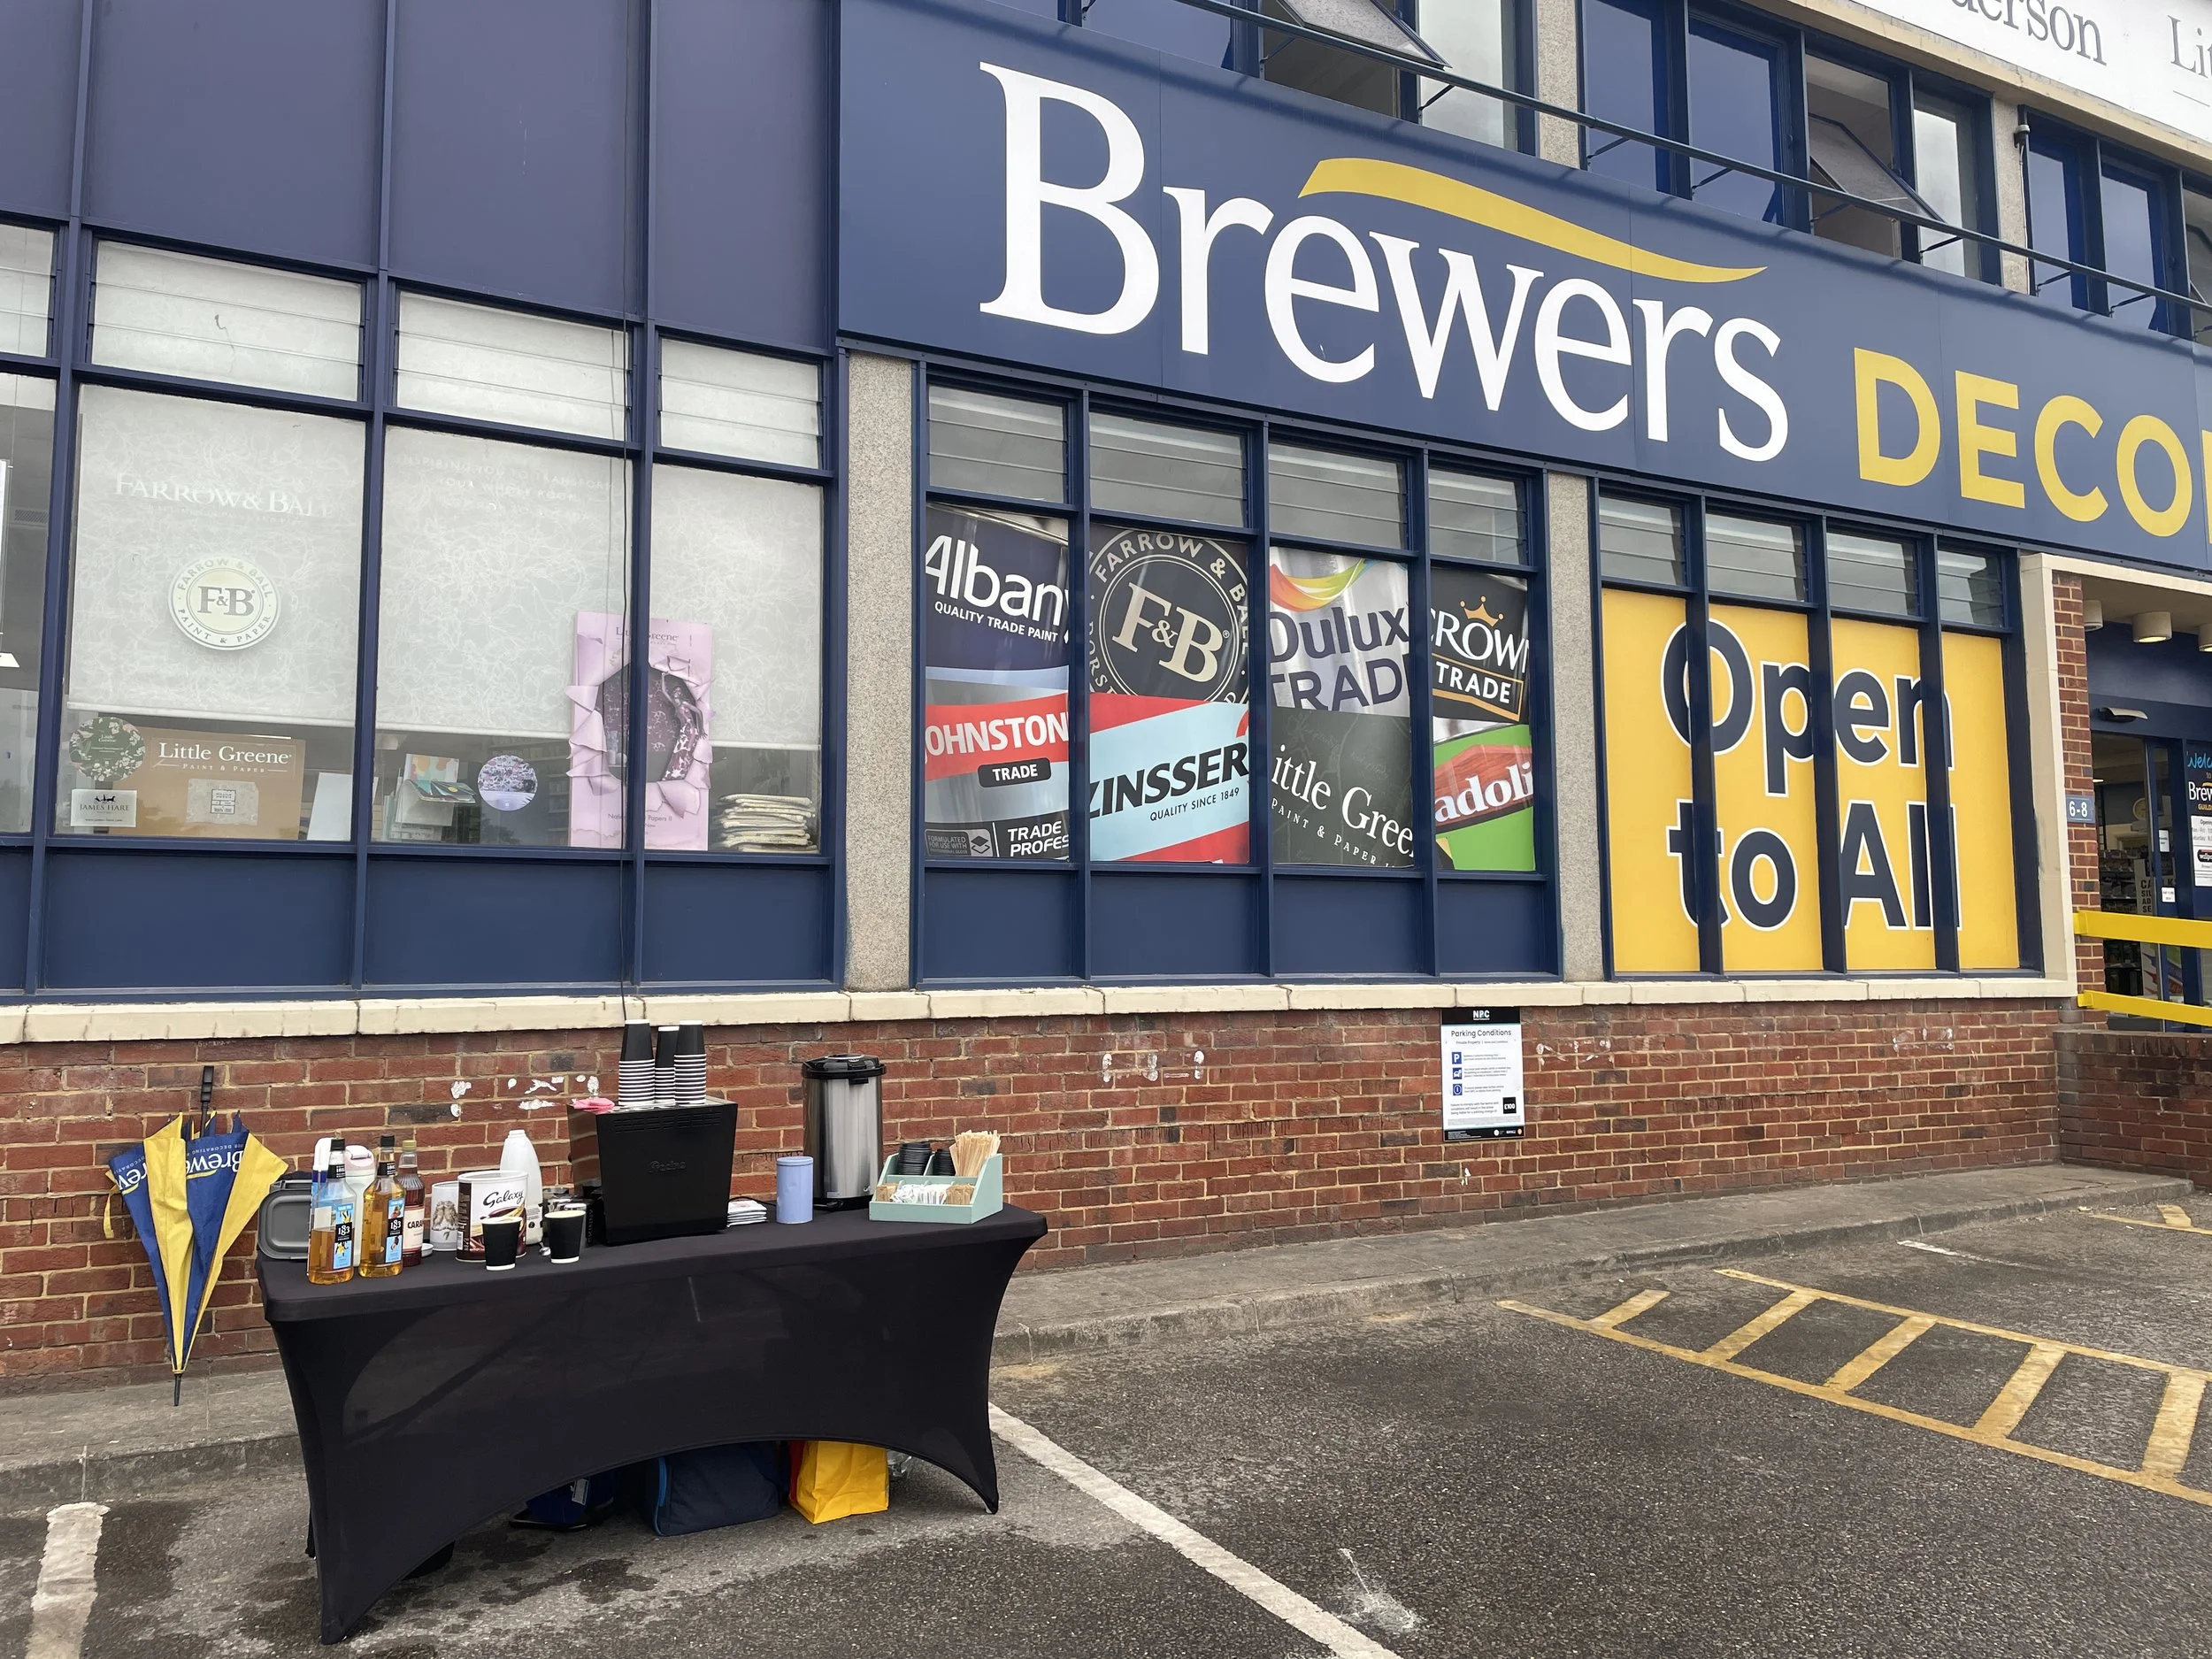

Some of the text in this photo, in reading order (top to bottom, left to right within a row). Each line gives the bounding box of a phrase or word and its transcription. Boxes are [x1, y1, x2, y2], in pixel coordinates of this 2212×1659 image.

[2168, 15, 2212, 78] Li
[979, 61, 2212, 544] Brewers DECO
[116, 472, 242, 509] FARROW
[177, 558, 228, 590] FARROW
[1094, 533, 1203, 583] FARROW
[1210, 557, 1226, 580] &
[197, 586, 254, 616] F&B
[925, 534, 1069, 626] Alban
[178, 608, 211, 640] PAINT
[236, 616, 271, 642] PAPER
[934, 601, 1058, 642] QUALITY TRADE PAINT
[1111, 581, 1224, 683] F&B
[1270, 606, 1409, 663] Dulux
[1430, 607, 1529, 673] ROW
[1271, 653, 1410, 711] TRAD
[1435, 661, 1511, 704] TRADE
[1660, 618, 1955, 798] Open
[158, 741, 289, 764] Little Greene
[925, 711, 1069, 764] OHNSTON
[992, 764, 1039, 781] TRADE
[1149, 787, 1240, 821] QUALITY SINCE 1849
[1342, 787, 1414, 857] Gree
[2069, 801, 2088, 818] 6-8
[1007, 820, 1062, 841] TRADE
[1271, 798, 1377, 865] PAINT & PAPER
[1451, 1028, 1512, 1039] Parking Conditions
[483, 1190, 524, 1208] Galaxy
